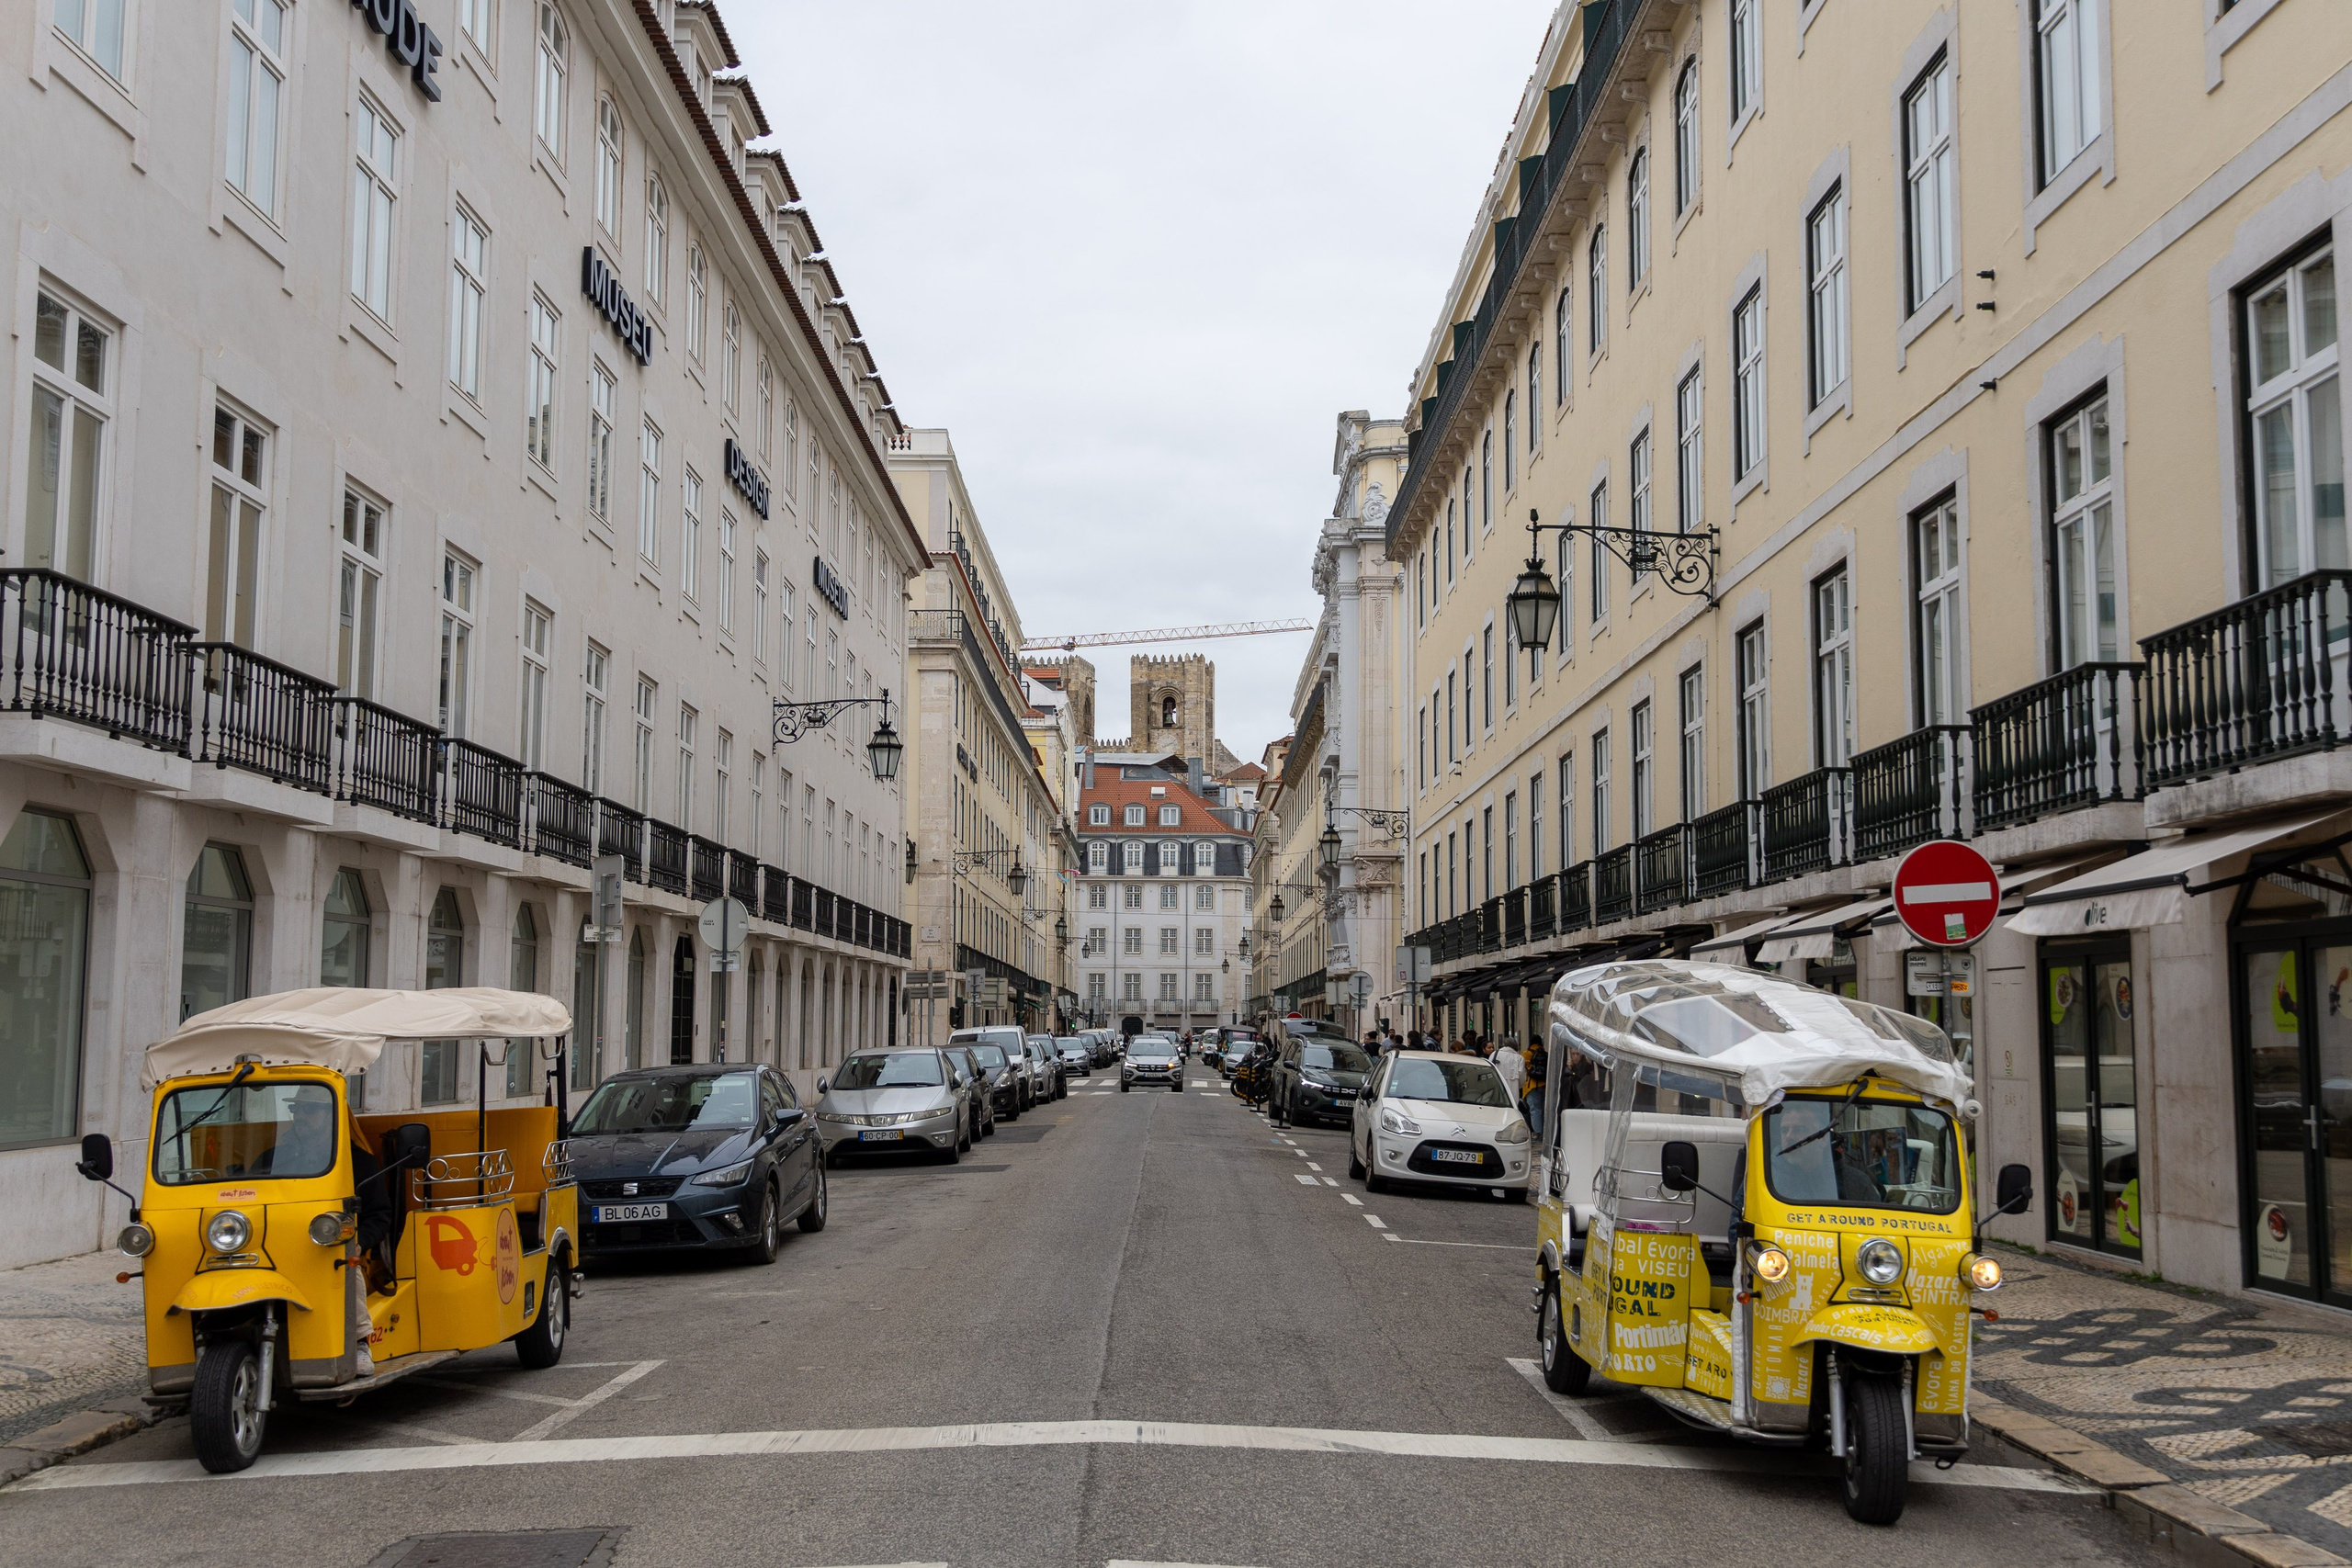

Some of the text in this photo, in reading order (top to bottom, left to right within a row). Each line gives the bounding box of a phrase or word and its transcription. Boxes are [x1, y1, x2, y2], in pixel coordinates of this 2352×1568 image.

[582, 246, 652, 367] MUSEU
[726, 439, 769, 520] DESIGN
[813, 556, 849, 621] MUSEUM
[1786, 1213, 1953, 1234] GET AROUND PORTUGAL
[1647, 1236, 1696, 1261] Évora
[1774, 1229, 1835, 1249] Peniche
[1786, 1249, 1838, 1269] Palmela
[1912, 1241, 1969, 1269] Algarve
[1637, 1258, 1690, 1278] VISEU
[1904, 1268, 1962, 1291] Nazaré
[1911, 1287, 1970, 1306] SINTRA
[1754, 1302, 1809, 1325] COIMBRA
[1614, 1319, 1688, 1349] Portimão
[1829, 1323, 1883, 1345] Cascais
[1766, 1325, 1784, 1372] TOMAR
[1792, 1357, 1809, 1398] Nazaré
[1918, 1360, 1942, 1410] Évora
